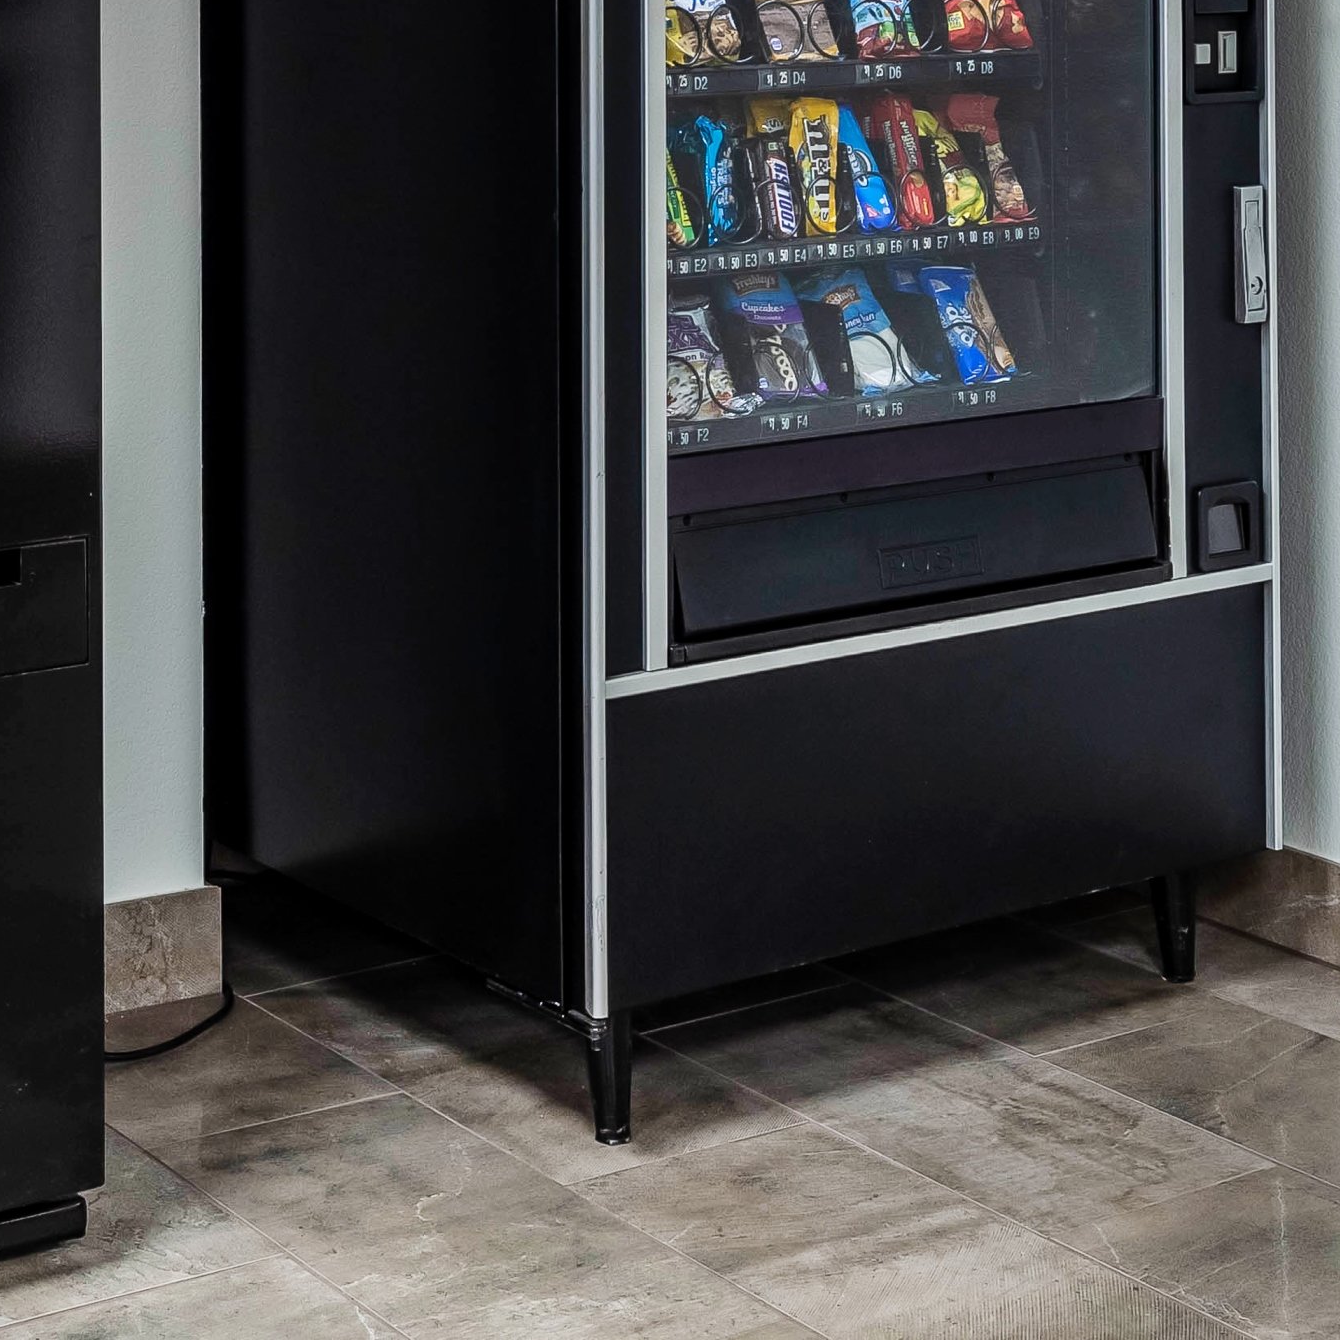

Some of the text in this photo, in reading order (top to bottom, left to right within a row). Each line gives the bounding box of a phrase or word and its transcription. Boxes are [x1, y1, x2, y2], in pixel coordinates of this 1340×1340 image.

[889, 66, 901, 78] D6
[981, 62, 993, 74] D8
[694, 77, 708, 90] D2
[793, 72, 806, 84] D4
[773, 161, 796, 232] FOOLISH
[983, 232, 994, 244] E8
[1028, 227, 1040, 239] E9
[891, 240, 902, 253] E6
[937, 236, 948, 248] E7
[795, 249, 806, 262] E4
[843, 244, 855, 258] E5
[695, 259, 706, 272] E2
[745, 255, 758, 267] E3
[741, 303, 786, 313] Cupcakes
[985, 391, 996, 403] F8
[891, 402, 903, 415] F6
[797, 415, 808, 429] F4
[697, 429, 709, 442] F2
[885, 541, 978, 577] PUSH
